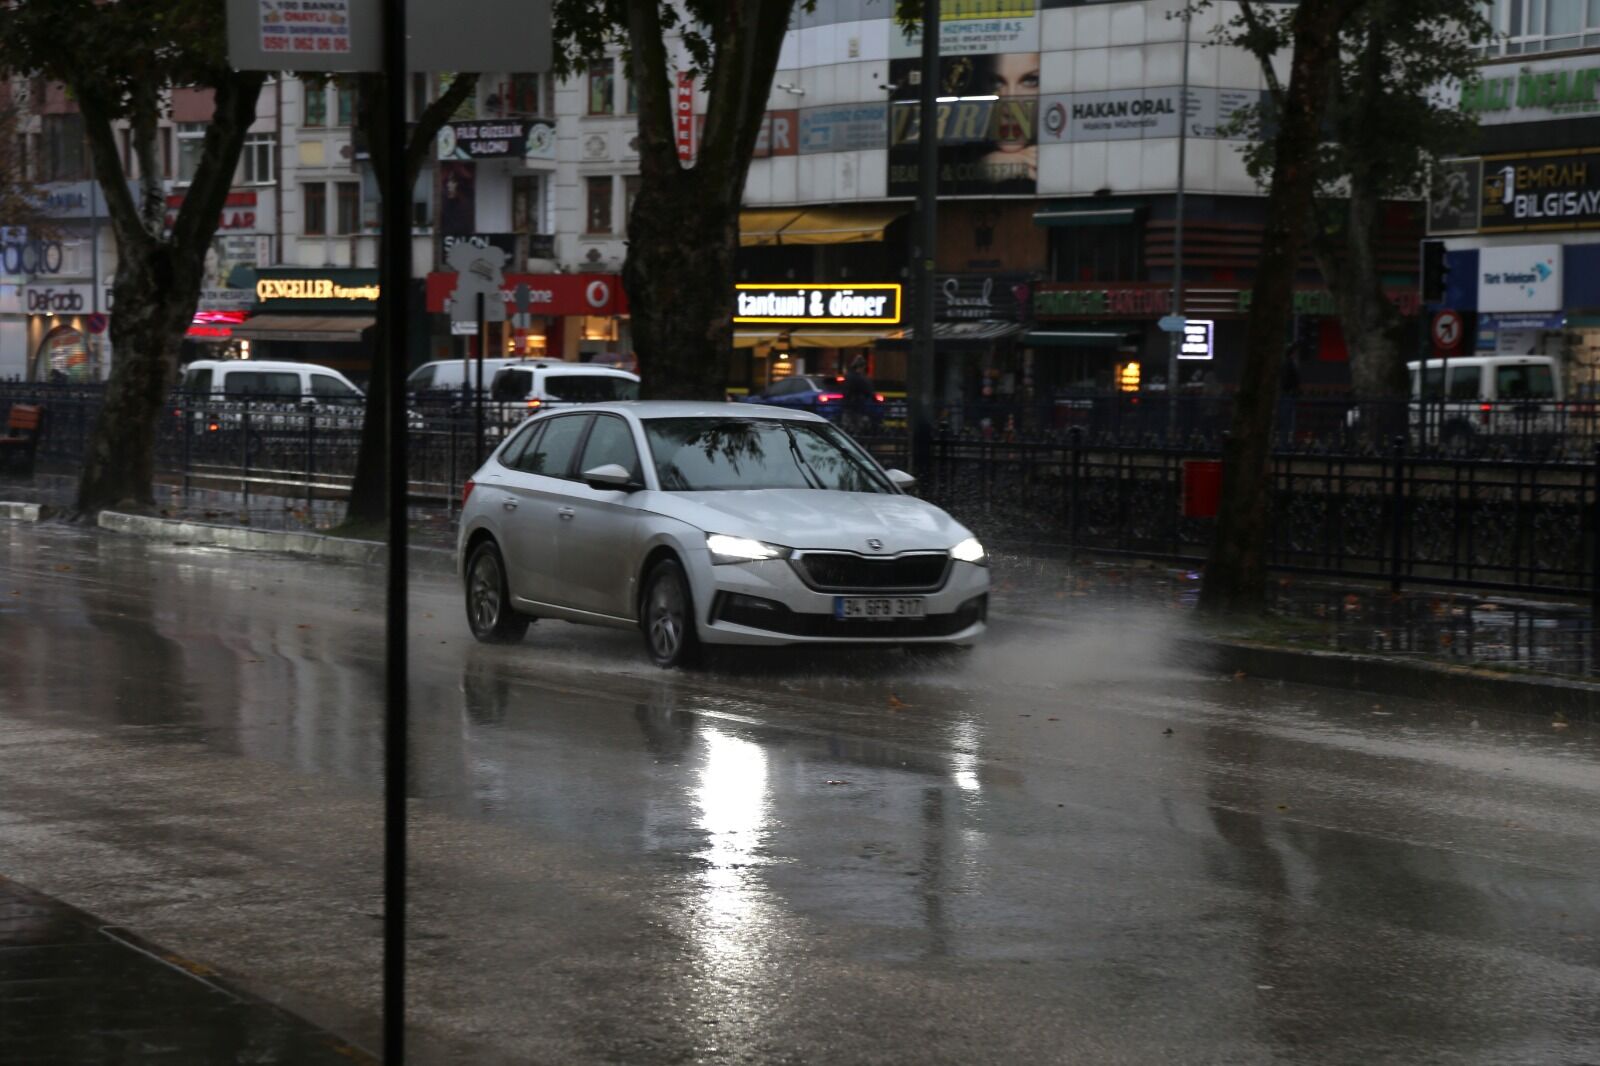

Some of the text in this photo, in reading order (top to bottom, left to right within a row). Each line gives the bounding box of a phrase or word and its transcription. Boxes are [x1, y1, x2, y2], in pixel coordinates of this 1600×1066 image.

[1072, 102, 1128, 119] HAKAN
[1131, 99, 1176, 115] ORAL
[1516, 163, 1588, 190] EMRAH
[1514, 189, 1600, 219] BİLGİSAY
[1484, 272, 1537, 284] Türk Telekom
[27, 289, 83, 311] DeFacto
[738, 290, 887, 316] tantuni & döner
